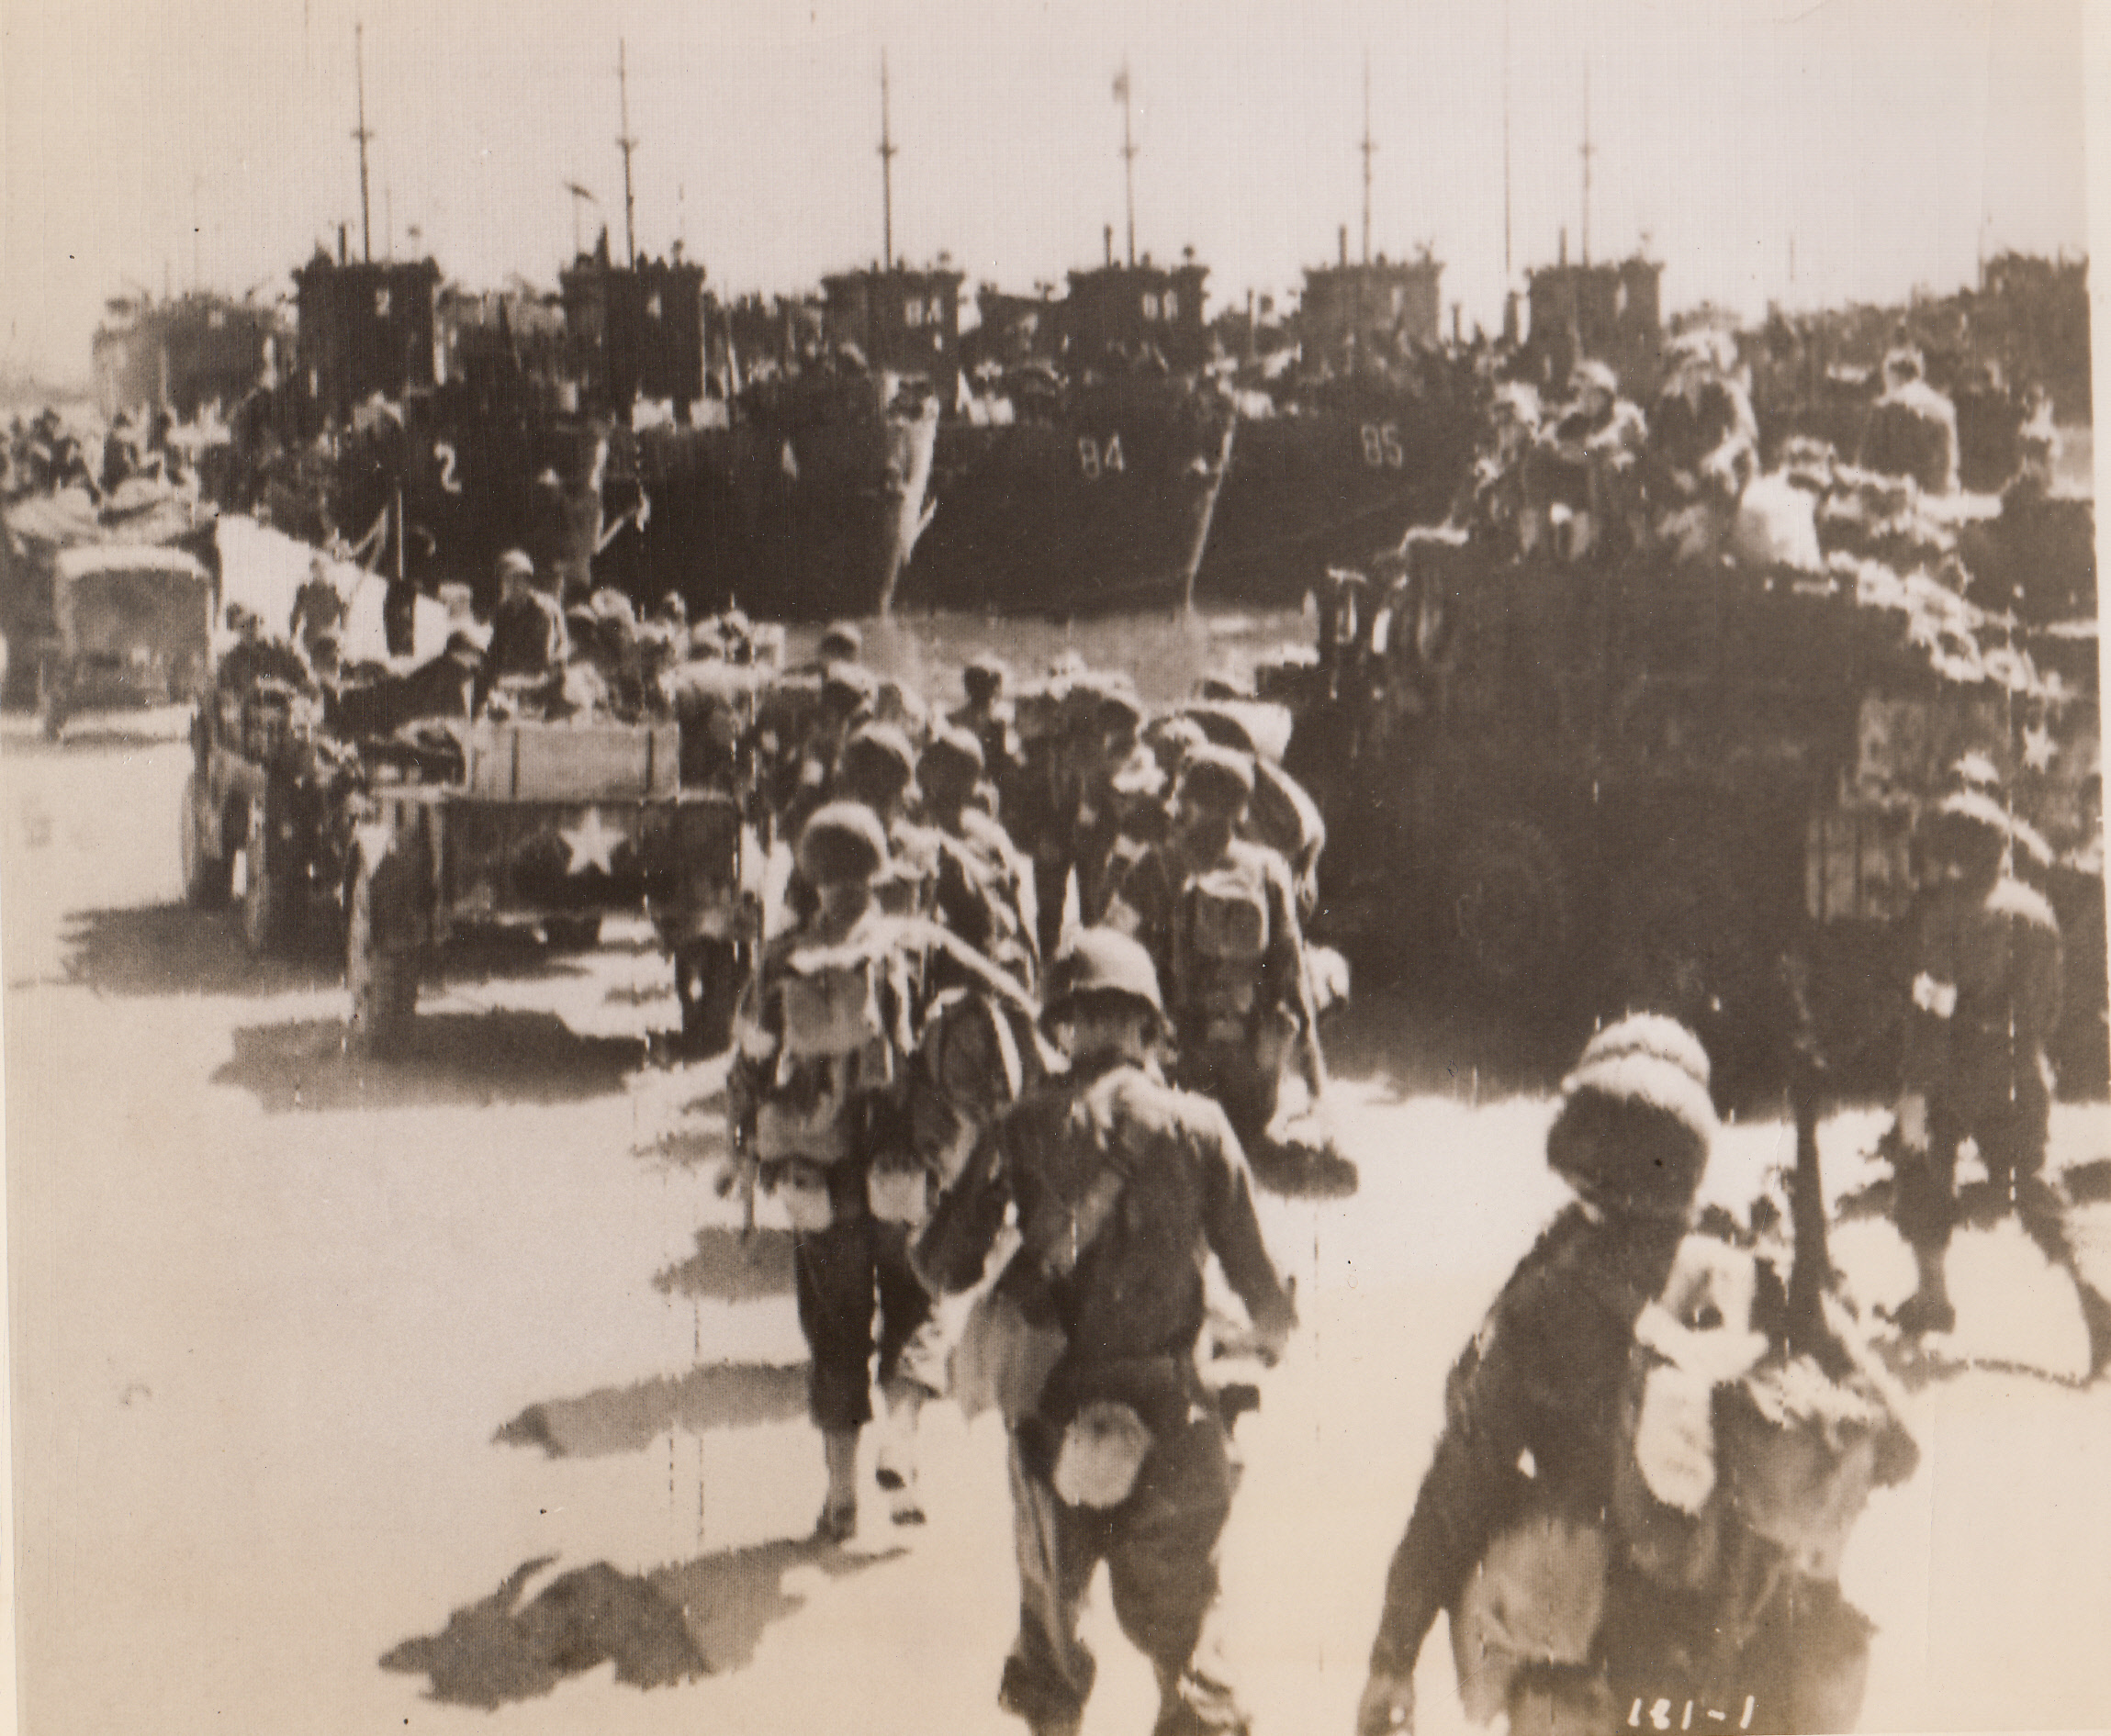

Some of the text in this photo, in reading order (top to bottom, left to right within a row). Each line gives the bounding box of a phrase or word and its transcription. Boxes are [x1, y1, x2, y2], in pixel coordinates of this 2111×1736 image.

[434, 442, 462, 492] 2
[1078, 433, 1124, 477] 84
[1361, 423, 1402, 467] 85
